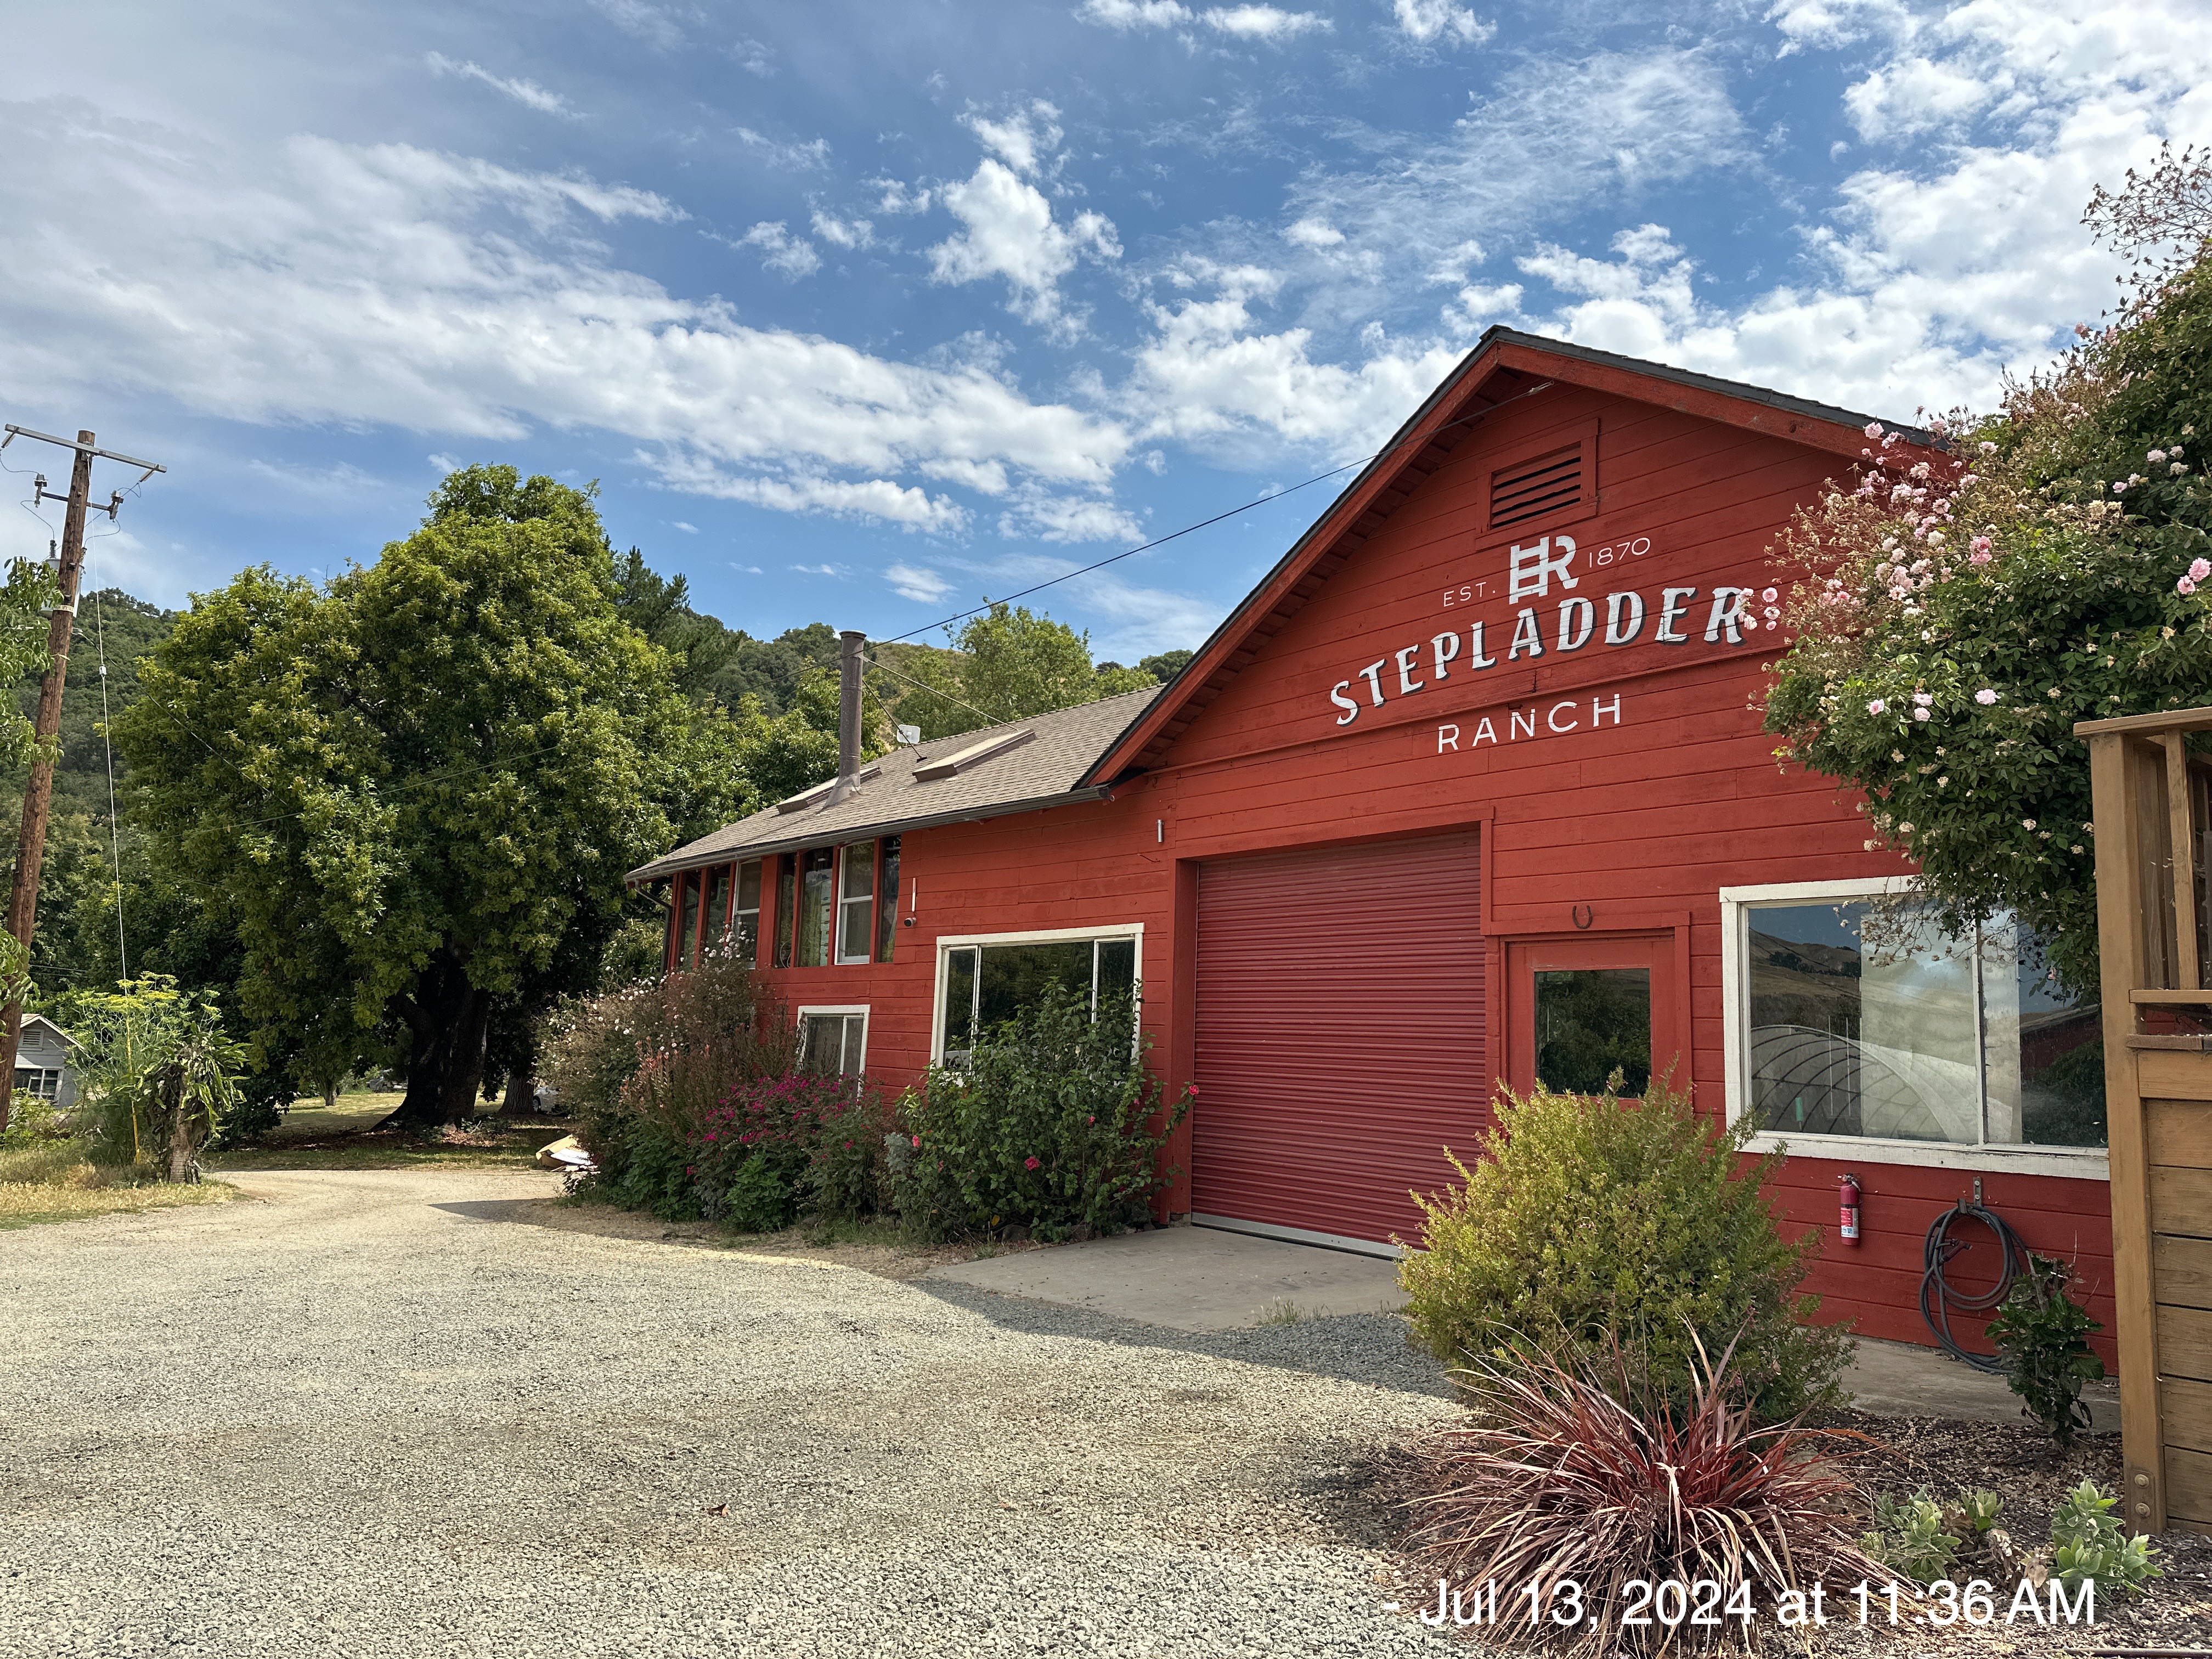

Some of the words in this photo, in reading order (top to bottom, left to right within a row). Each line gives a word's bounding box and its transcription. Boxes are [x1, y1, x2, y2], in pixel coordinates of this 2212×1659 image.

[1443, 582, 1496, 607] EST.
[1589, 537, 1651, 568] 1870
[1330, 586, 1747, 726] STEPLADDER
[1438, 693, 1621, 754] RANCH
